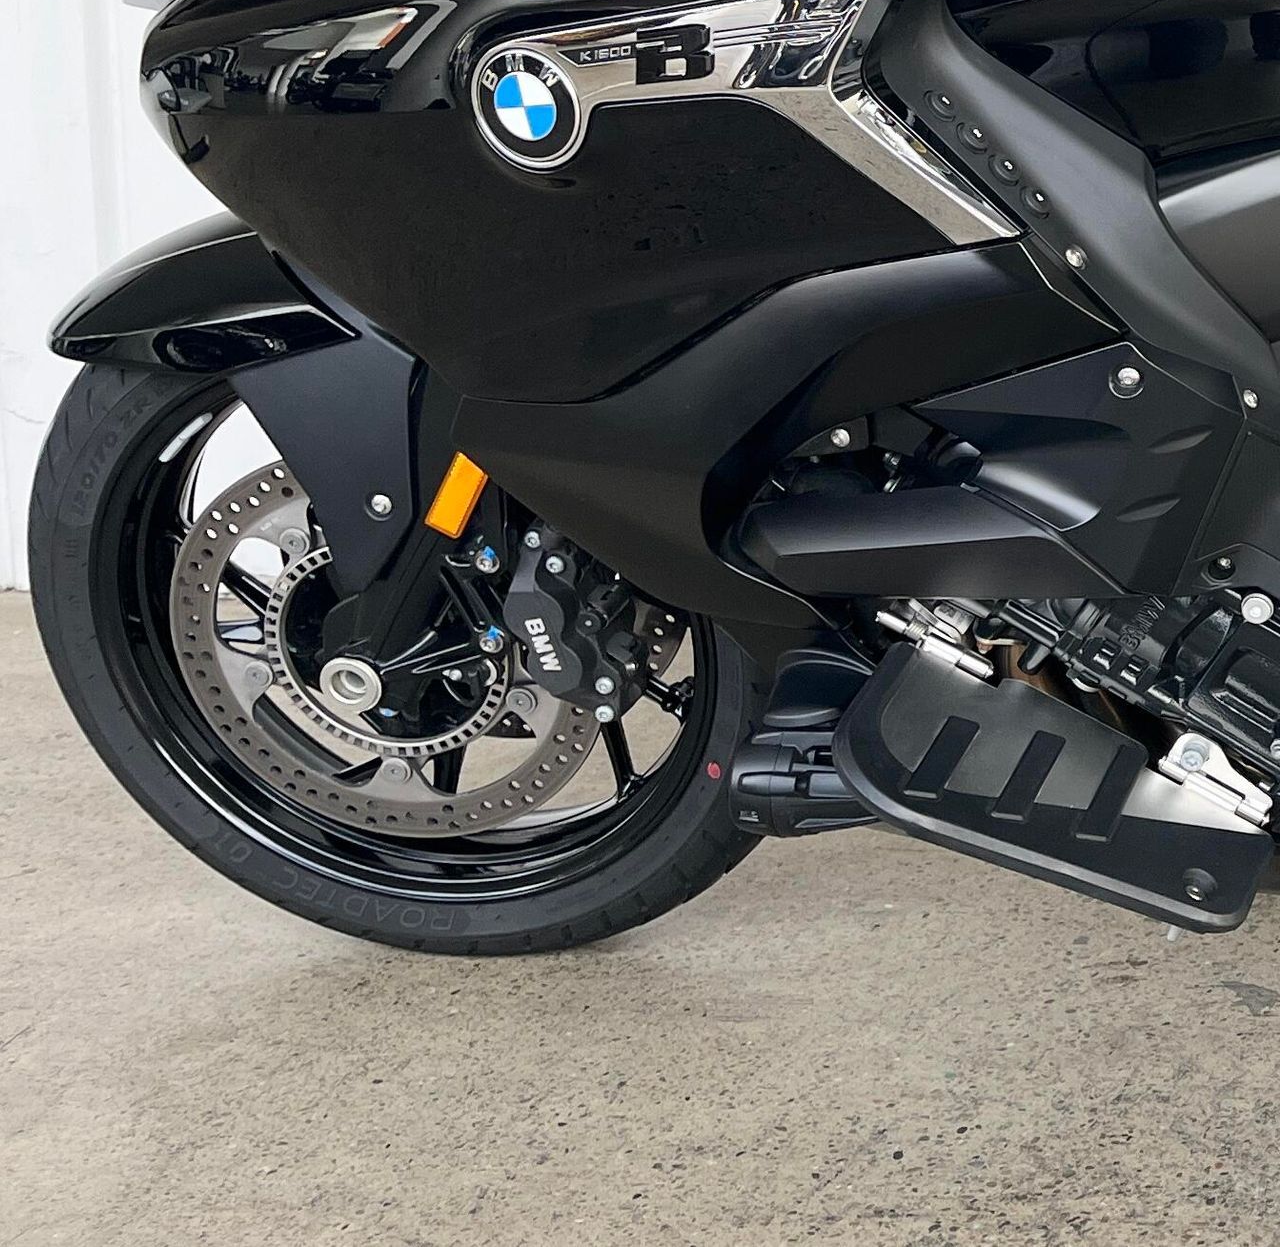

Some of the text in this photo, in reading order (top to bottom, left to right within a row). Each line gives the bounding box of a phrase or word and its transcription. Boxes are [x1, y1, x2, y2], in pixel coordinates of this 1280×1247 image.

[481, 53, 560, 92] BMW
[635, 23, 716, 86] B
[524, 617, 563, 672] BMW
[1118, 595, 1166, 650] BMW
[272, 864, 458, 931] ROADTEC
